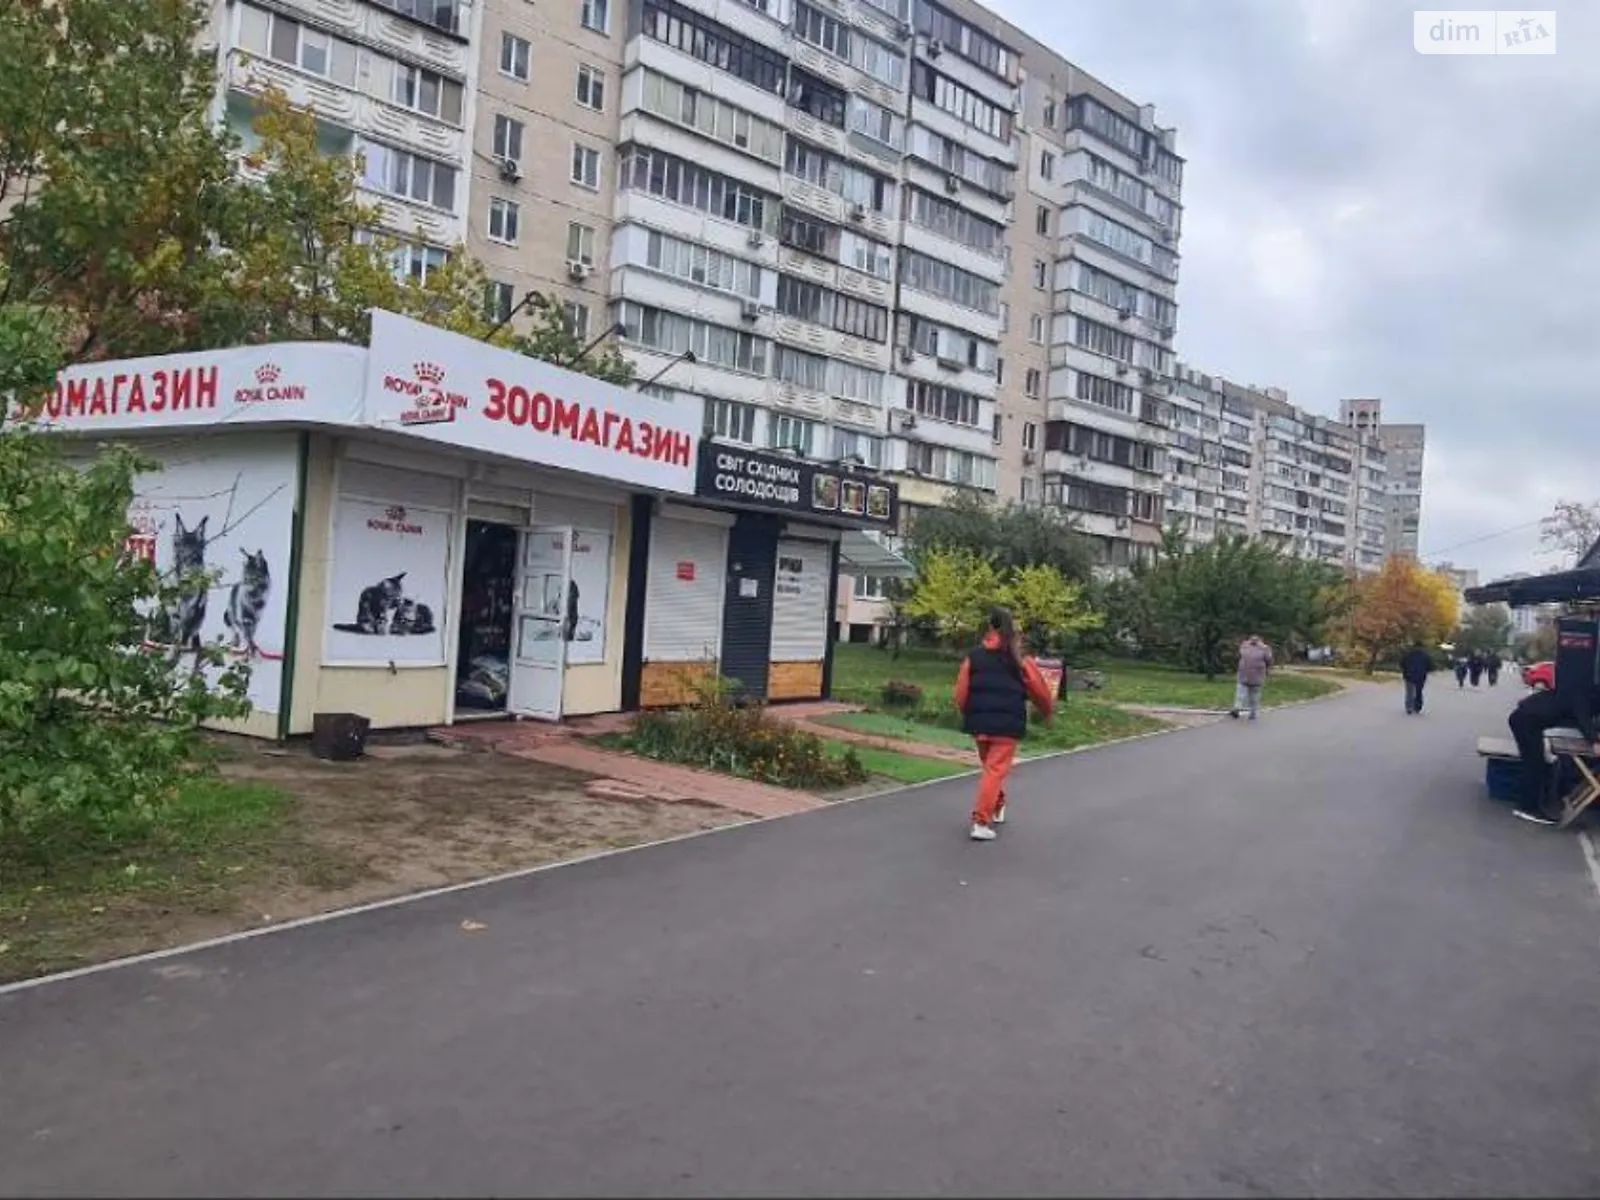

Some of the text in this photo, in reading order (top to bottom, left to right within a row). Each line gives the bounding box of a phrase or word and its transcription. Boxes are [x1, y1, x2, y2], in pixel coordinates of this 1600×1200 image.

[11, 366, 219, 420] ОМАГАЗИН
[483, 378, 691, 467] ЗООМАГАЗИН
[716, 453, 745, 472] СВІТ
